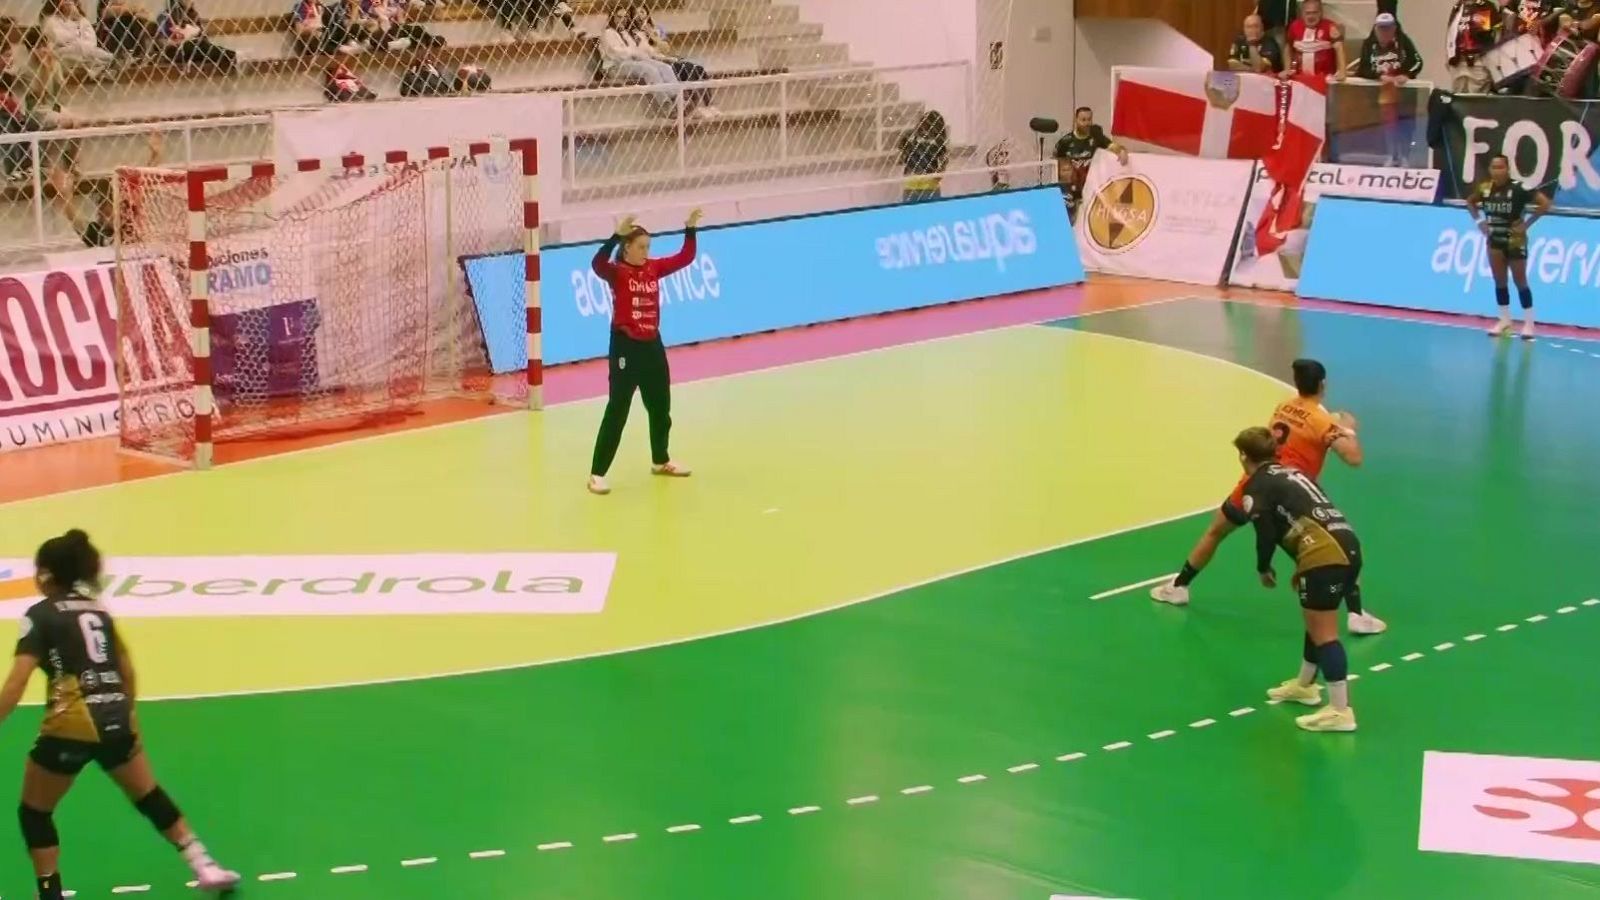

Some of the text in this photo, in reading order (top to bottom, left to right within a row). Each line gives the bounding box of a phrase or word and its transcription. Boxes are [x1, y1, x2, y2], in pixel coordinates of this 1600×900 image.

[1462, 115, 1600, 190] FOR
[0, 261, 196, 401] OCHA
[78, 611, 108, 664] 6
